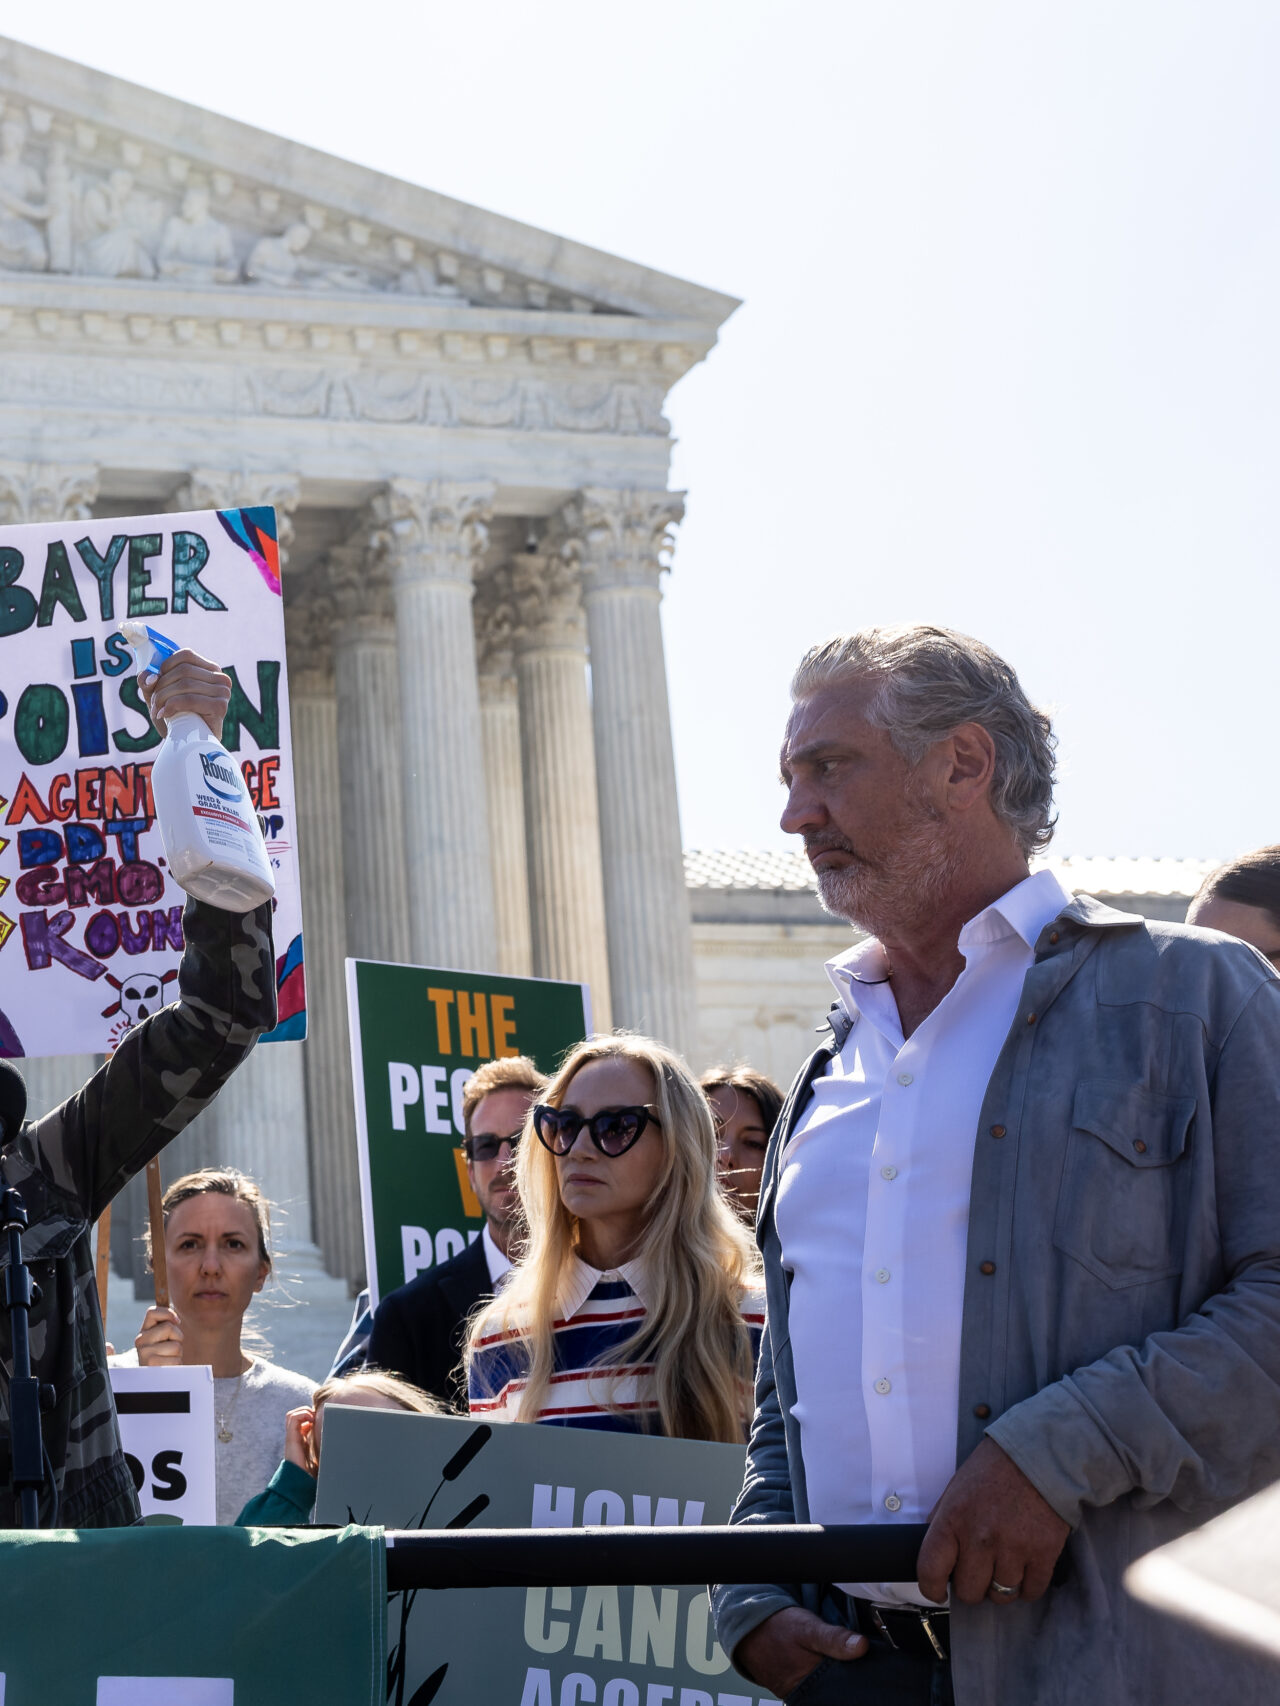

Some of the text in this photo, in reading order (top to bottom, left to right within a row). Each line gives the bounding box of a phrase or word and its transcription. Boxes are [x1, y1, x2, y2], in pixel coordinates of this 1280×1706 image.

[70, 632, 133, 680] IS
[5, 761, 157, 826] AGENT
[196, 793, 216, 803] WEED
[198, 800, 221, 810] GRASS
[17, 818, 153, 869] DDT
[16, 855, 175, 909] GMO'
[427, 987, 520, 1059] THE
[522, 1584, 732, 1676] CANC
